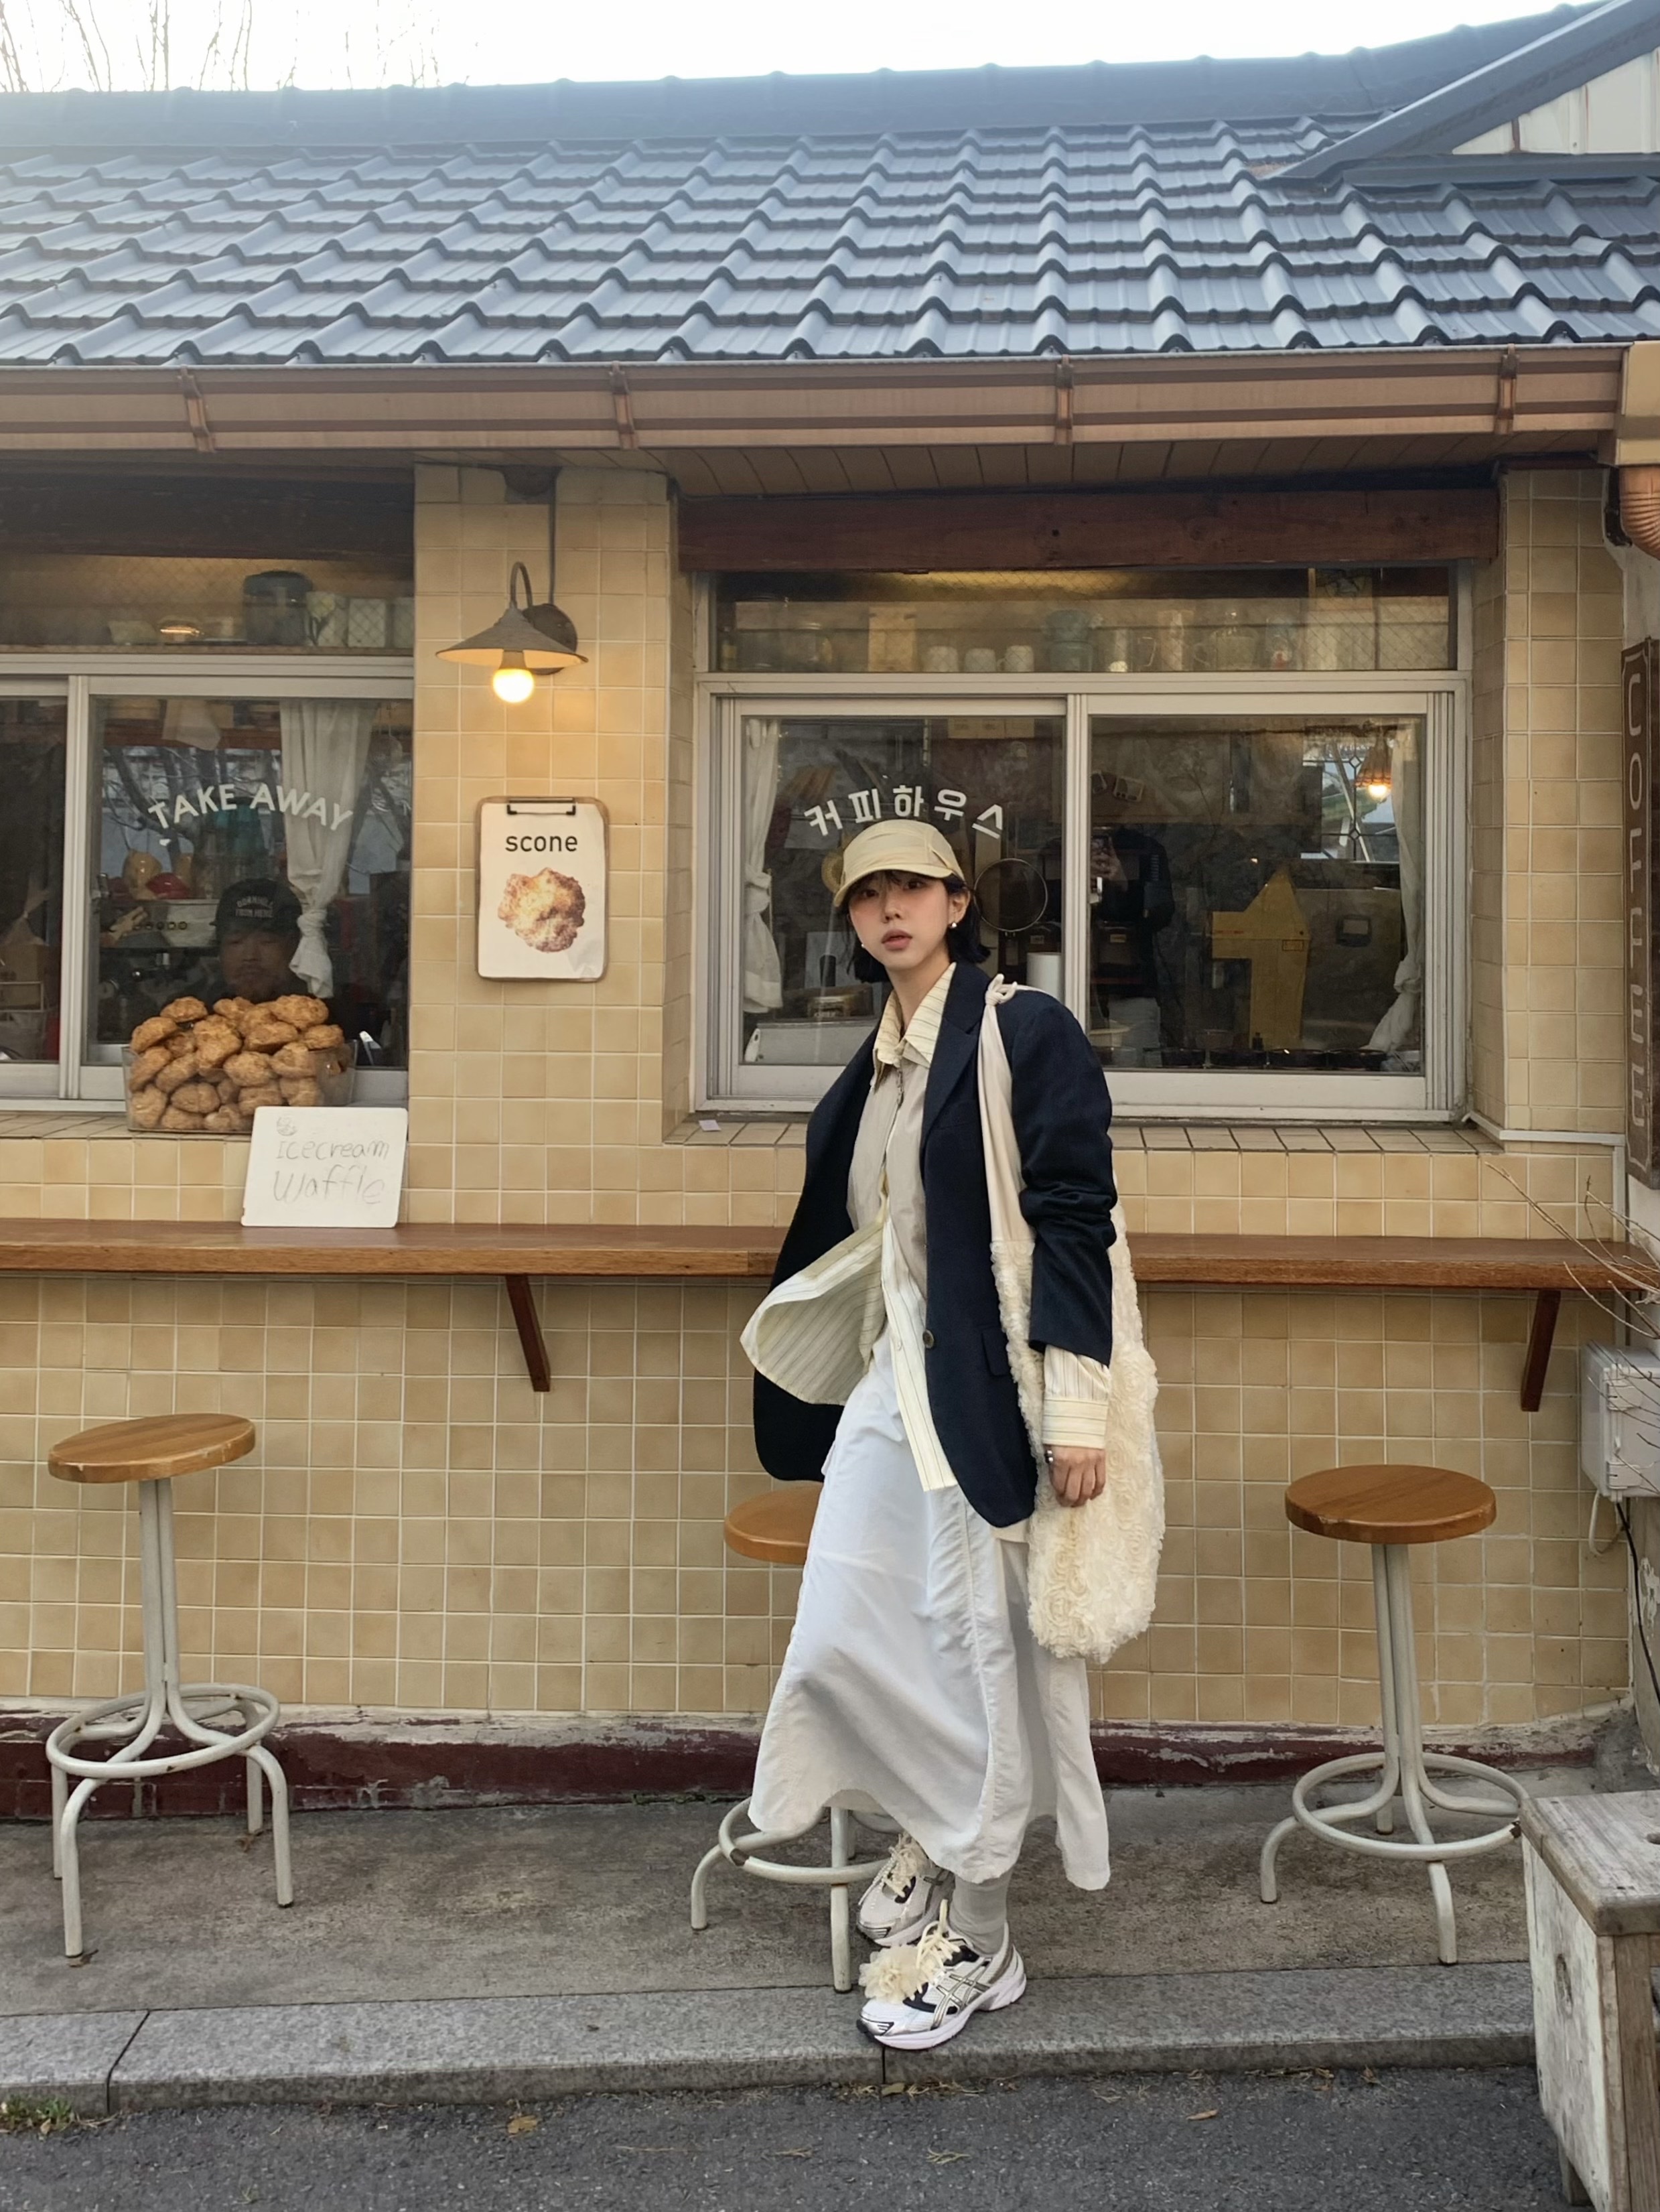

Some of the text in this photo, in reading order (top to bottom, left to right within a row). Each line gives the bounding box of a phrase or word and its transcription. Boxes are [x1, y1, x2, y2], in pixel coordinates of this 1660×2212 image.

[148, 782, 353, 831] TAKE AWAY
[804, 784, 1003, 839] 커피하우스
[505, 835, 578, 852] scone
[1628, 673, 1645, 1127] COFFEE
[273, 1164, 385, 1204] Waffle
